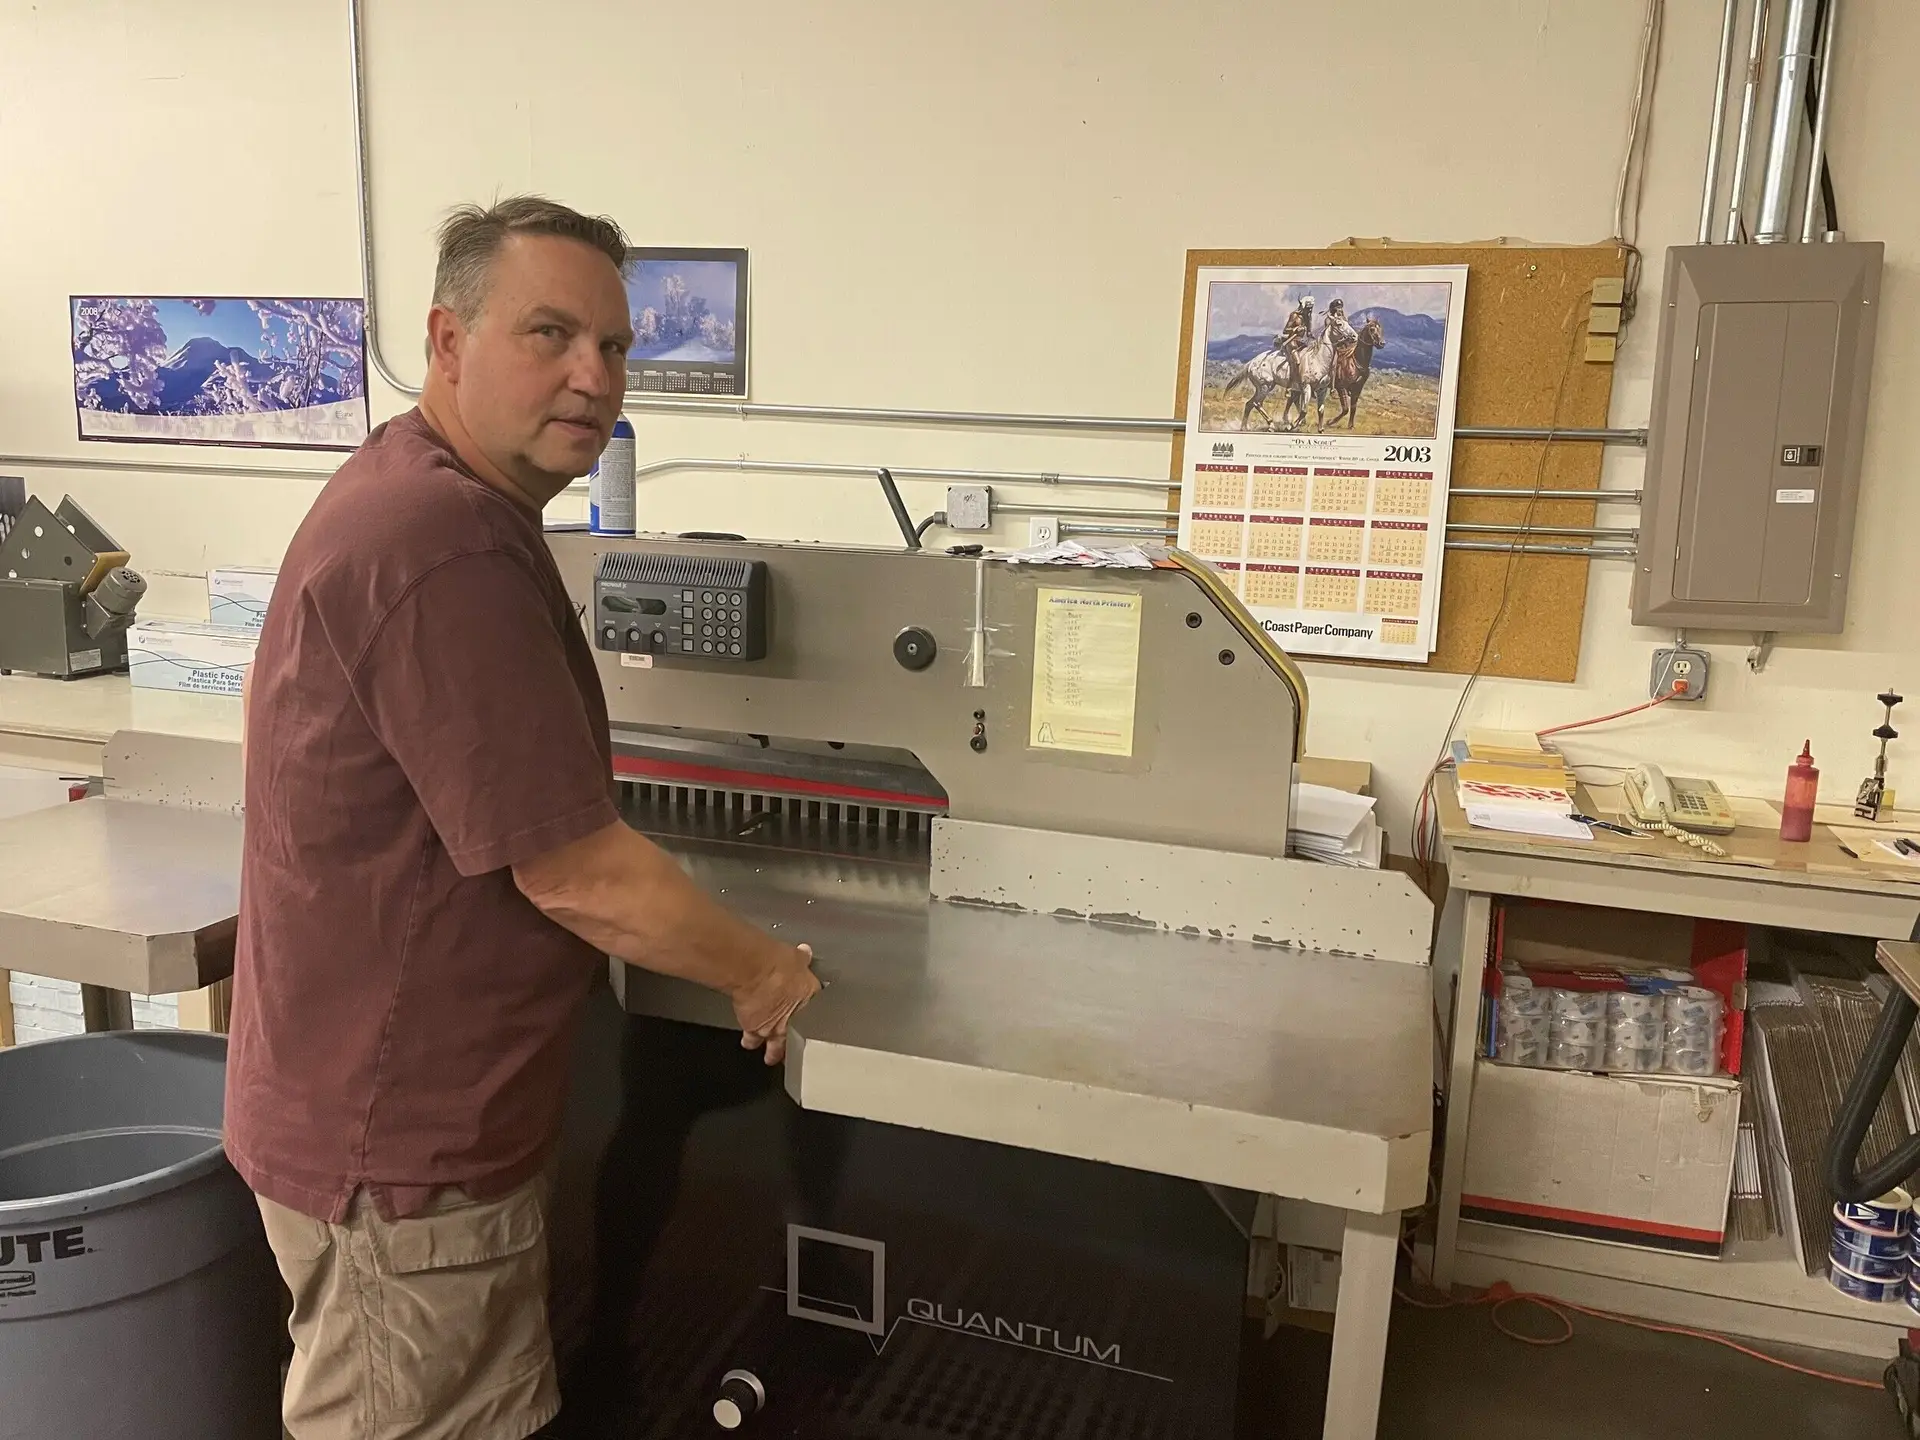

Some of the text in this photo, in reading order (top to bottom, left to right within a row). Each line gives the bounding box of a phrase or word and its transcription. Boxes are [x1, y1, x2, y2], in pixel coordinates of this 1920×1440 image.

[81, 307, 98, 315] 2008
[1383, 445, 1432, 463] 2003
[1265, 620, 1294, 632] Coast
[1295, 622, 1323, 635] Paper
[1325, 624, 1373, 639] Company
[188, 676, 211, 684] Plastica
[192, 670, 218, 679] Plastic
[906, 1298, 1121, 1364] QUANTUM
